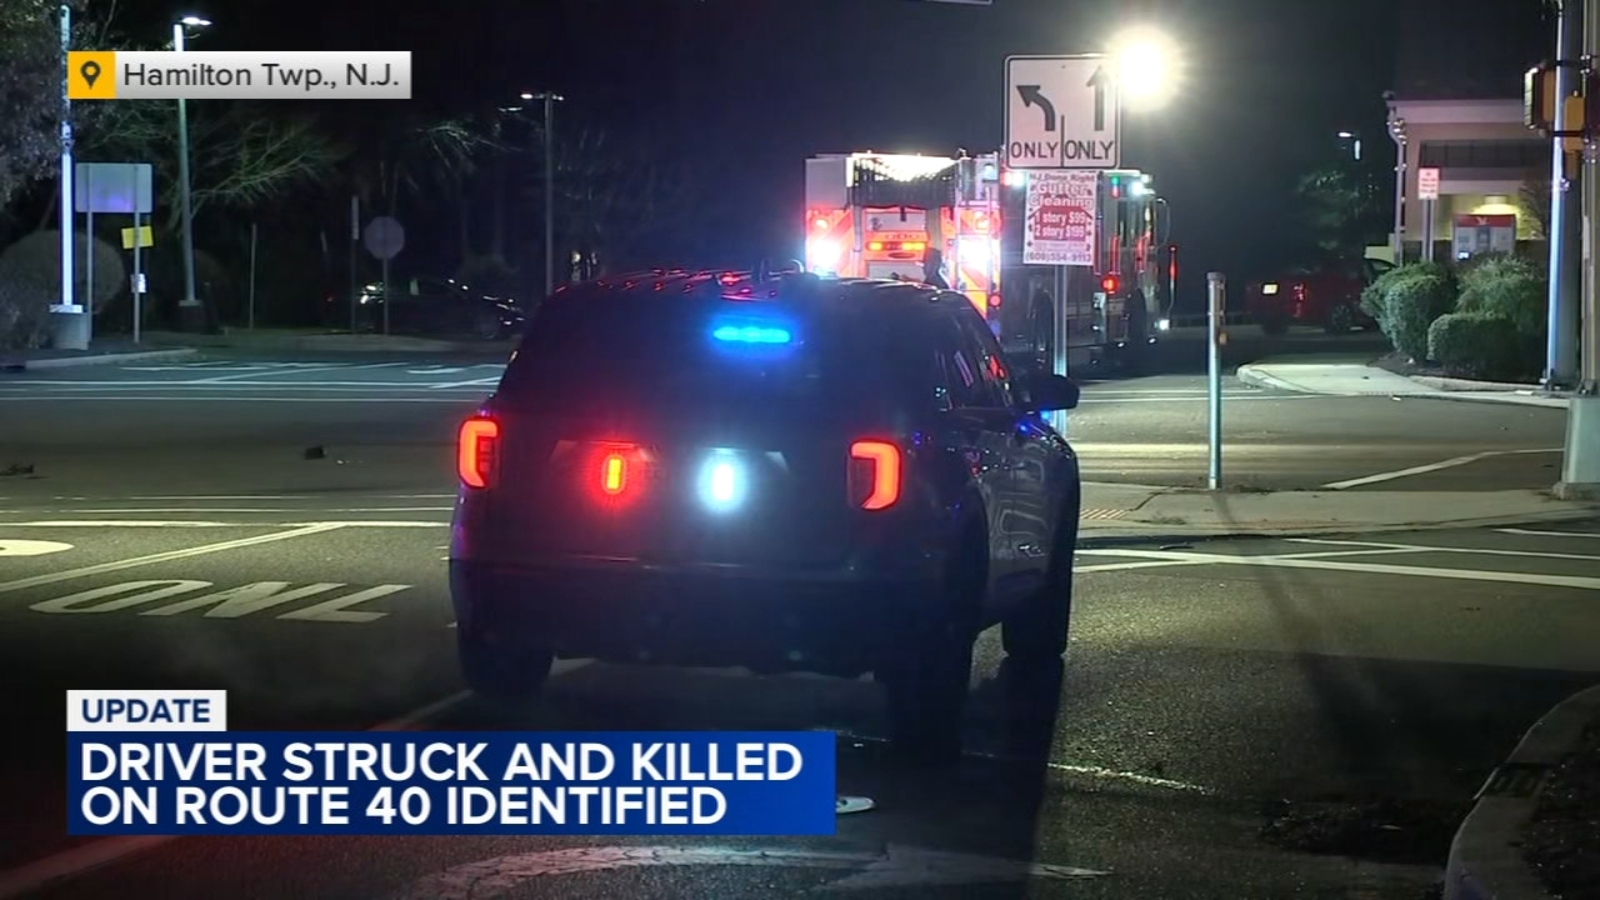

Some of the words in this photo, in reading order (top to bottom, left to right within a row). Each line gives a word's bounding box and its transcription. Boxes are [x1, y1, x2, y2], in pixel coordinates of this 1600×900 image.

[1010, 141, 1059, 159] ONLY
[1065, 139, 1114, 160] ONLY
[1029, 194, 1094, 210] Cleaning
[1035, 211, 1040, 223] 1
[1042, 212, 1067, 226] story
[1035, 224, 1041, 237] 2
[1042, 226, 1065, 240] story
